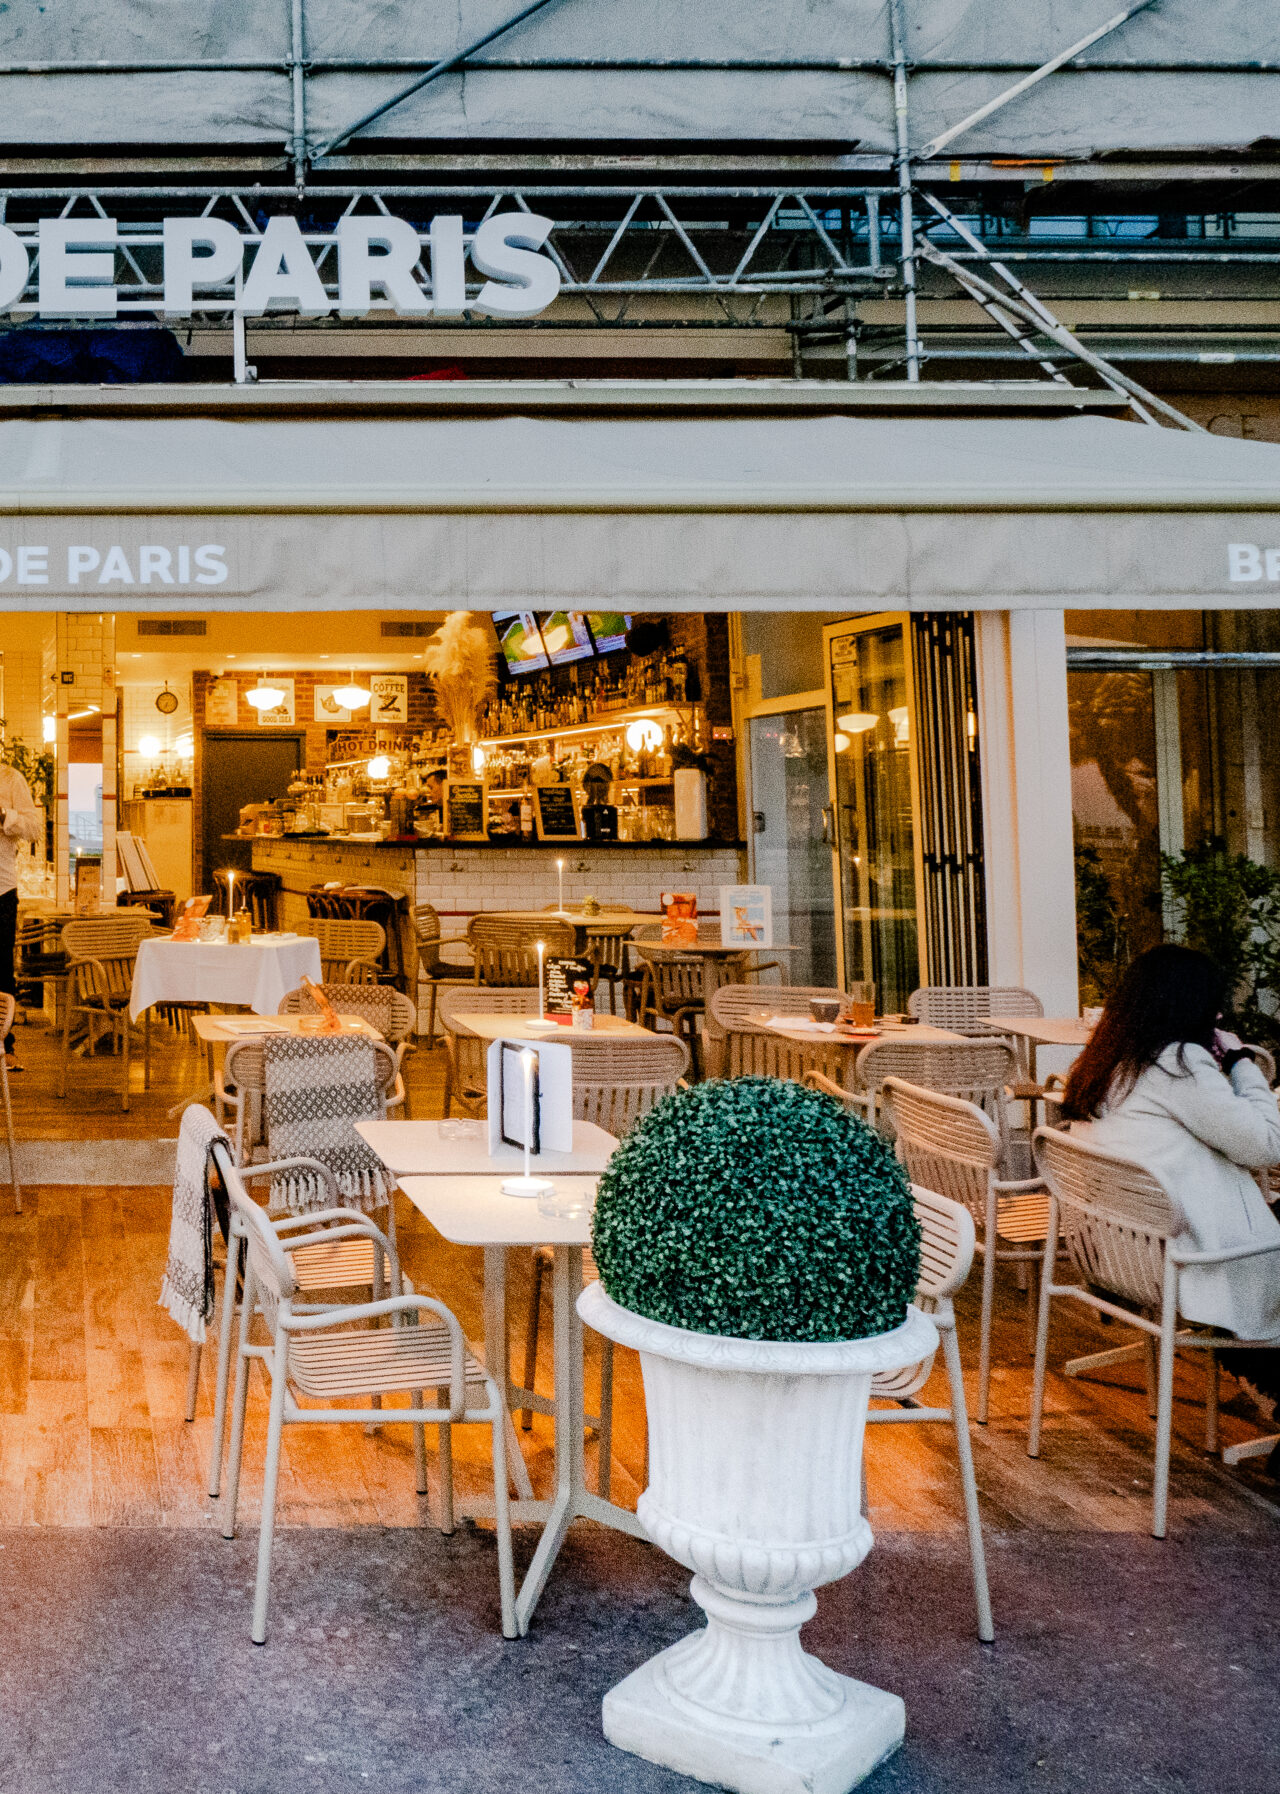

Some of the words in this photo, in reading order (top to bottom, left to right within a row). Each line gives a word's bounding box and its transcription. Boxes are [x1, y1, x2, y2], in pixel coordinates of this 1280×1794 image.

[162, 212, 561, 318] PARIS
[68, 544, 229, 586] PARIS
[373, 683, 405, 693] COFFEE
[338, 741, 364, 752] HOT
[369, 740, 421, 753] DRINKS
